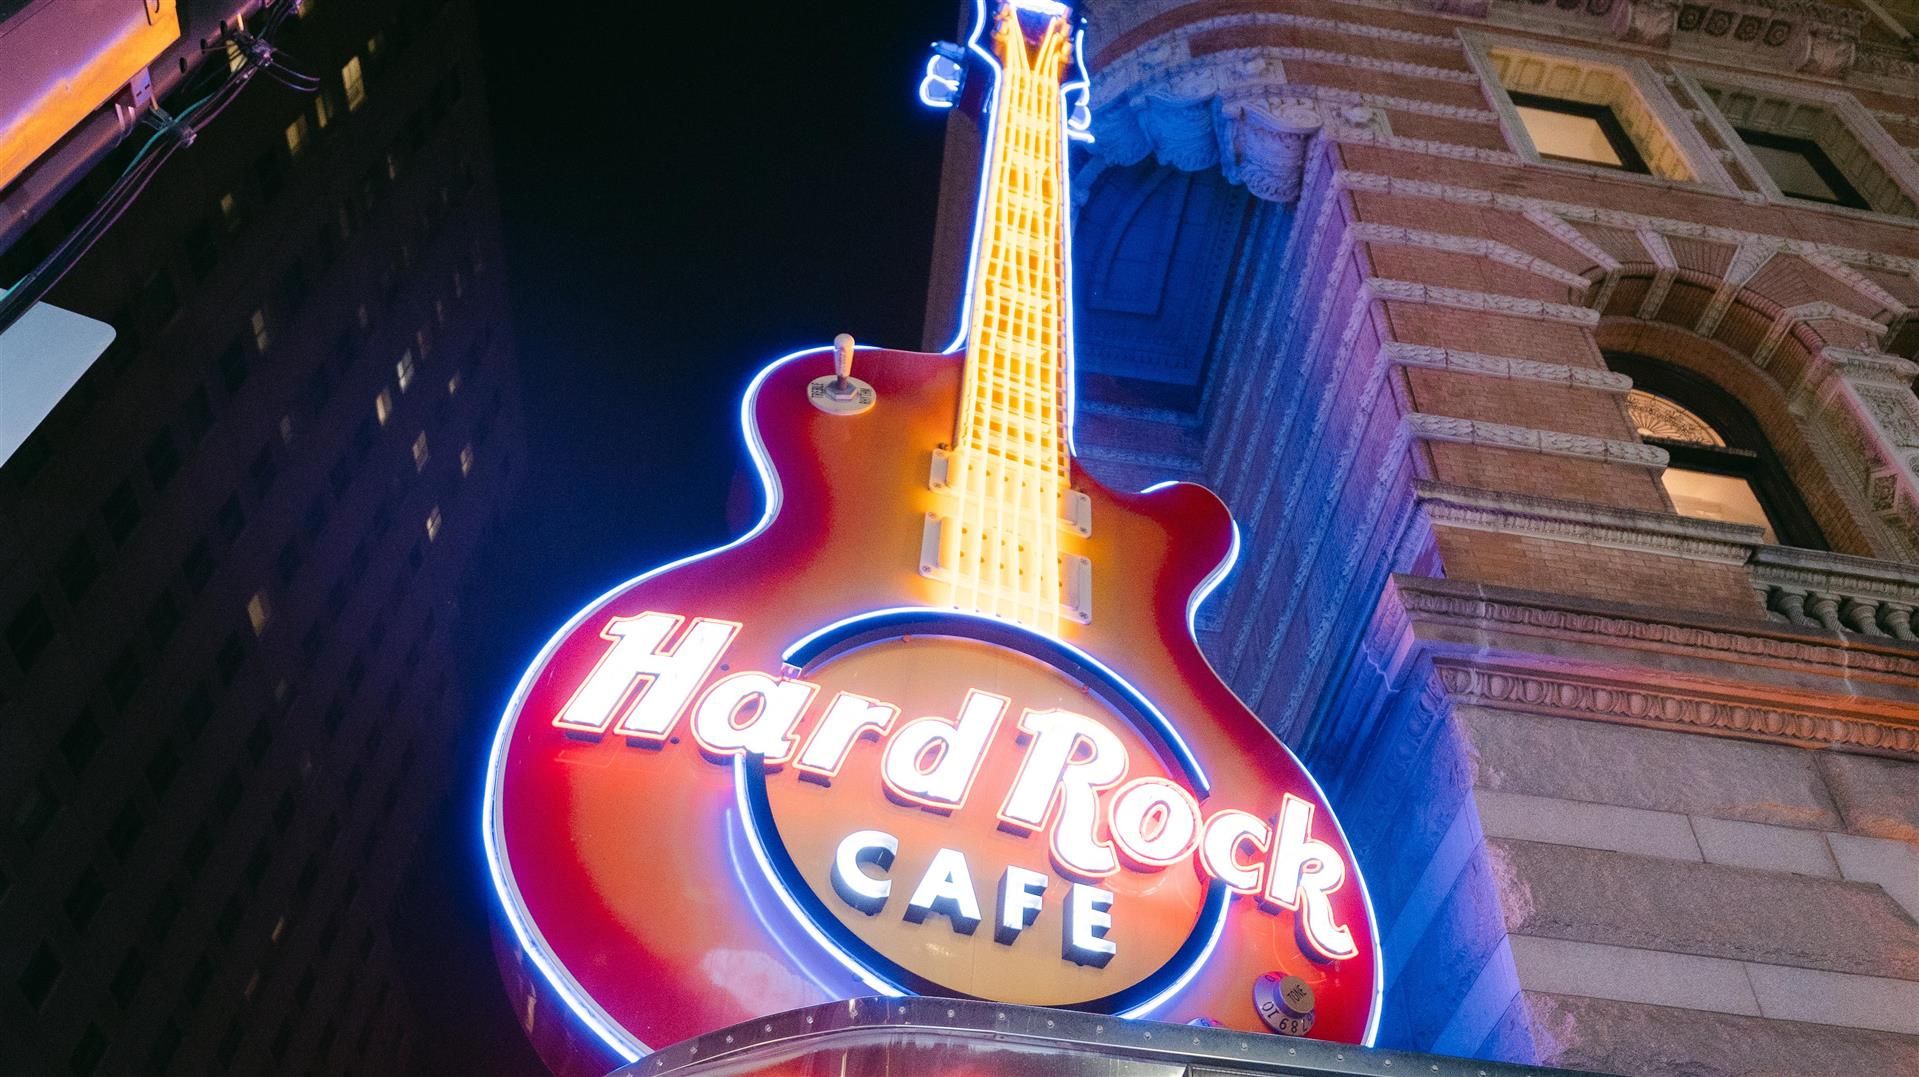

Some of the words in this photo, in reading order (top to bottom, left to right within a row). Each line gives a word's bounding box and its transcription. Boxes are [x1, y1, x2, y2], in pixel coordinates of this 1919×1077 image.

[552, 611, 1011, 812] Hard
[996, 708, 1359, 960] Rock
[831, 830, 1116, 967] CAFE
[1286, 984, 1307, 1003] TONE
[1291, 1020, 1298, 1033] 8
